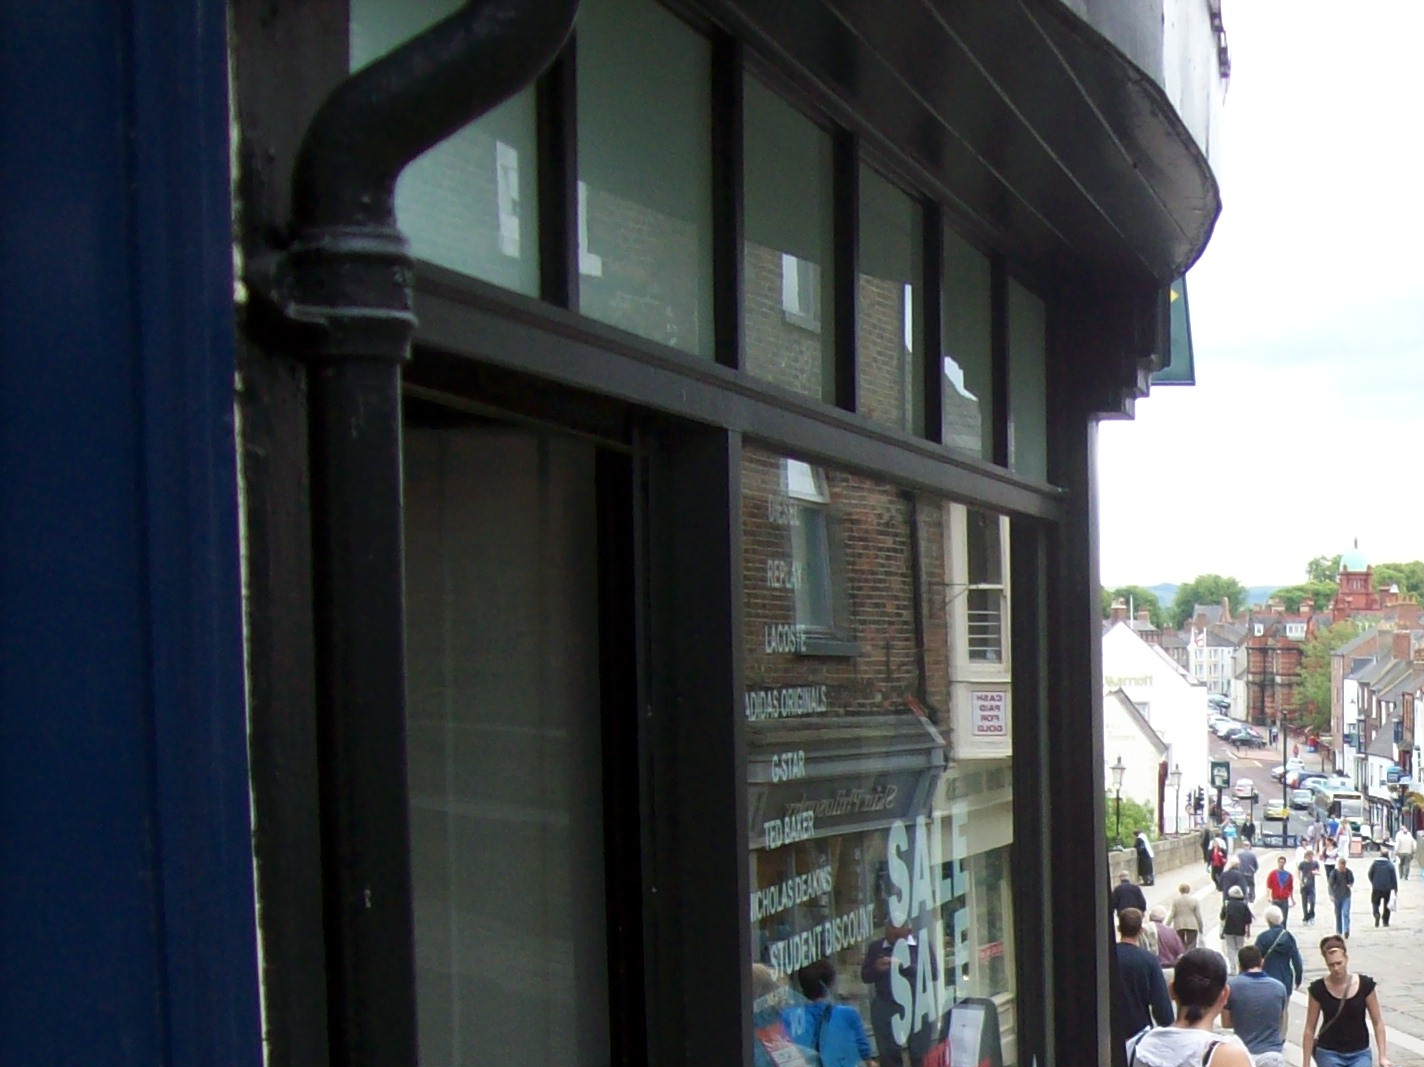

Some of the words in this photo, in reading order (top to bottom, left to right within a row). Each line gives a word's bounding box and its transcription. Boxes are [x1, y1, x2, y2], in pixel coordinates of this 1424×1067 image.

[764, 624, 806, 653] LACOSTE
[745, 689, 780, 721] ADIDAS
[772, 750, 806, 783] G-STAR
[763, 818, 784, 851] TED
[783, 810, 815, 845] BAKER
[888, 801, 970, 929] SALE
[769, 925, 823, 982] STUDENT
[824, 903, 875, 957] DISCOUNT
[891, 907, 970, 1046] SALE
